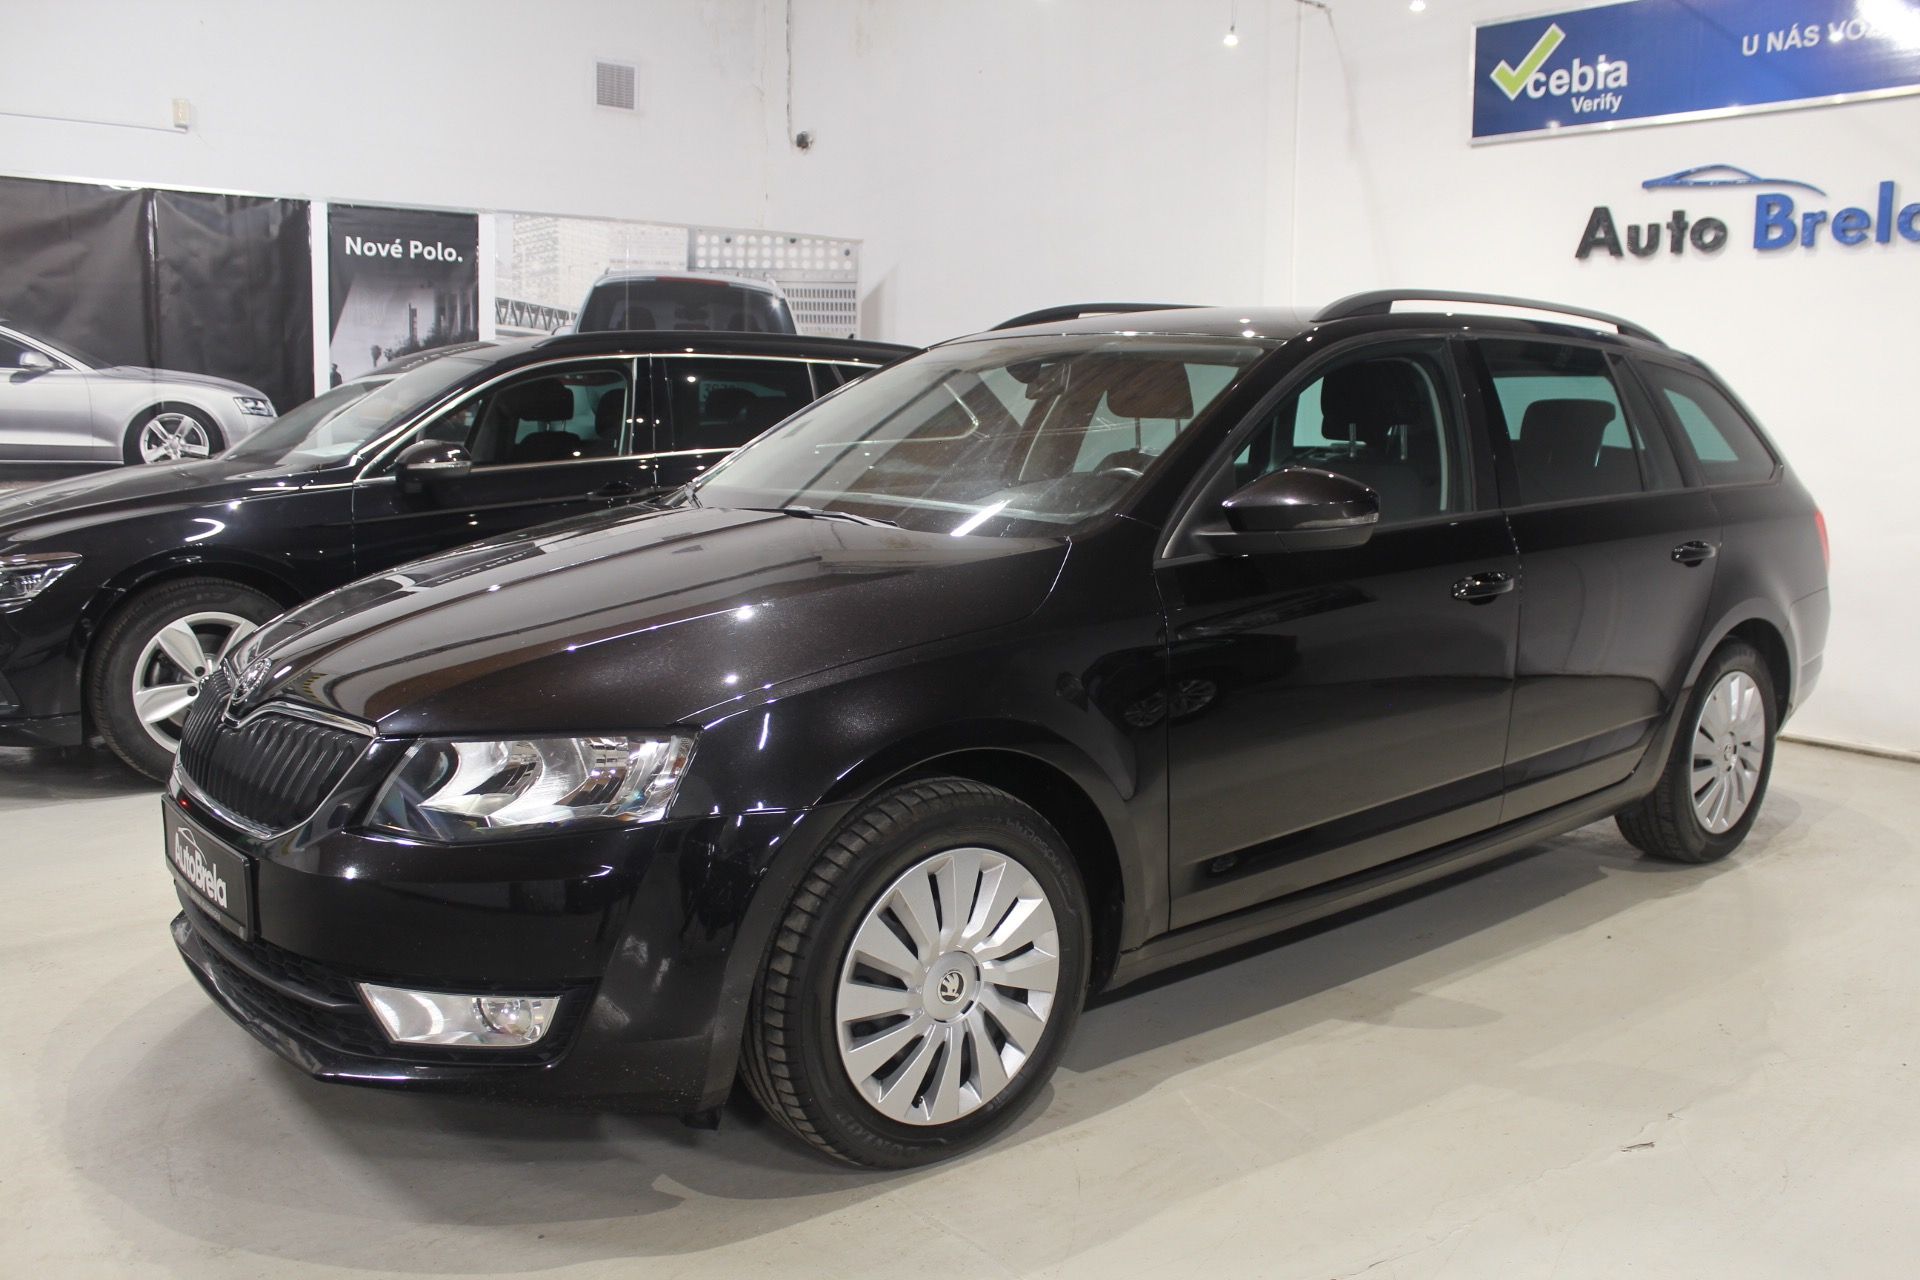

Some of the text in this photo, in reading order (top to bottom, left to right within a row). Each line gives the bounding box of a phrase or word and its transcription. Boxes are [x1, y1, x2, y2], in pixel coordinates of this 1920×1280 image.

[1742, 33, 1759, 57] U
[1766, 22, 1821, 53] NÁS
[1526, 53, 1628, 99] cebia
[1571, 92, 1623, 115] Verify
[344, 235, 464, 263] Nové Polo.
[1575, 205, 1729, 260] Auto
[174, 831, 228, 909] AutoBrela
